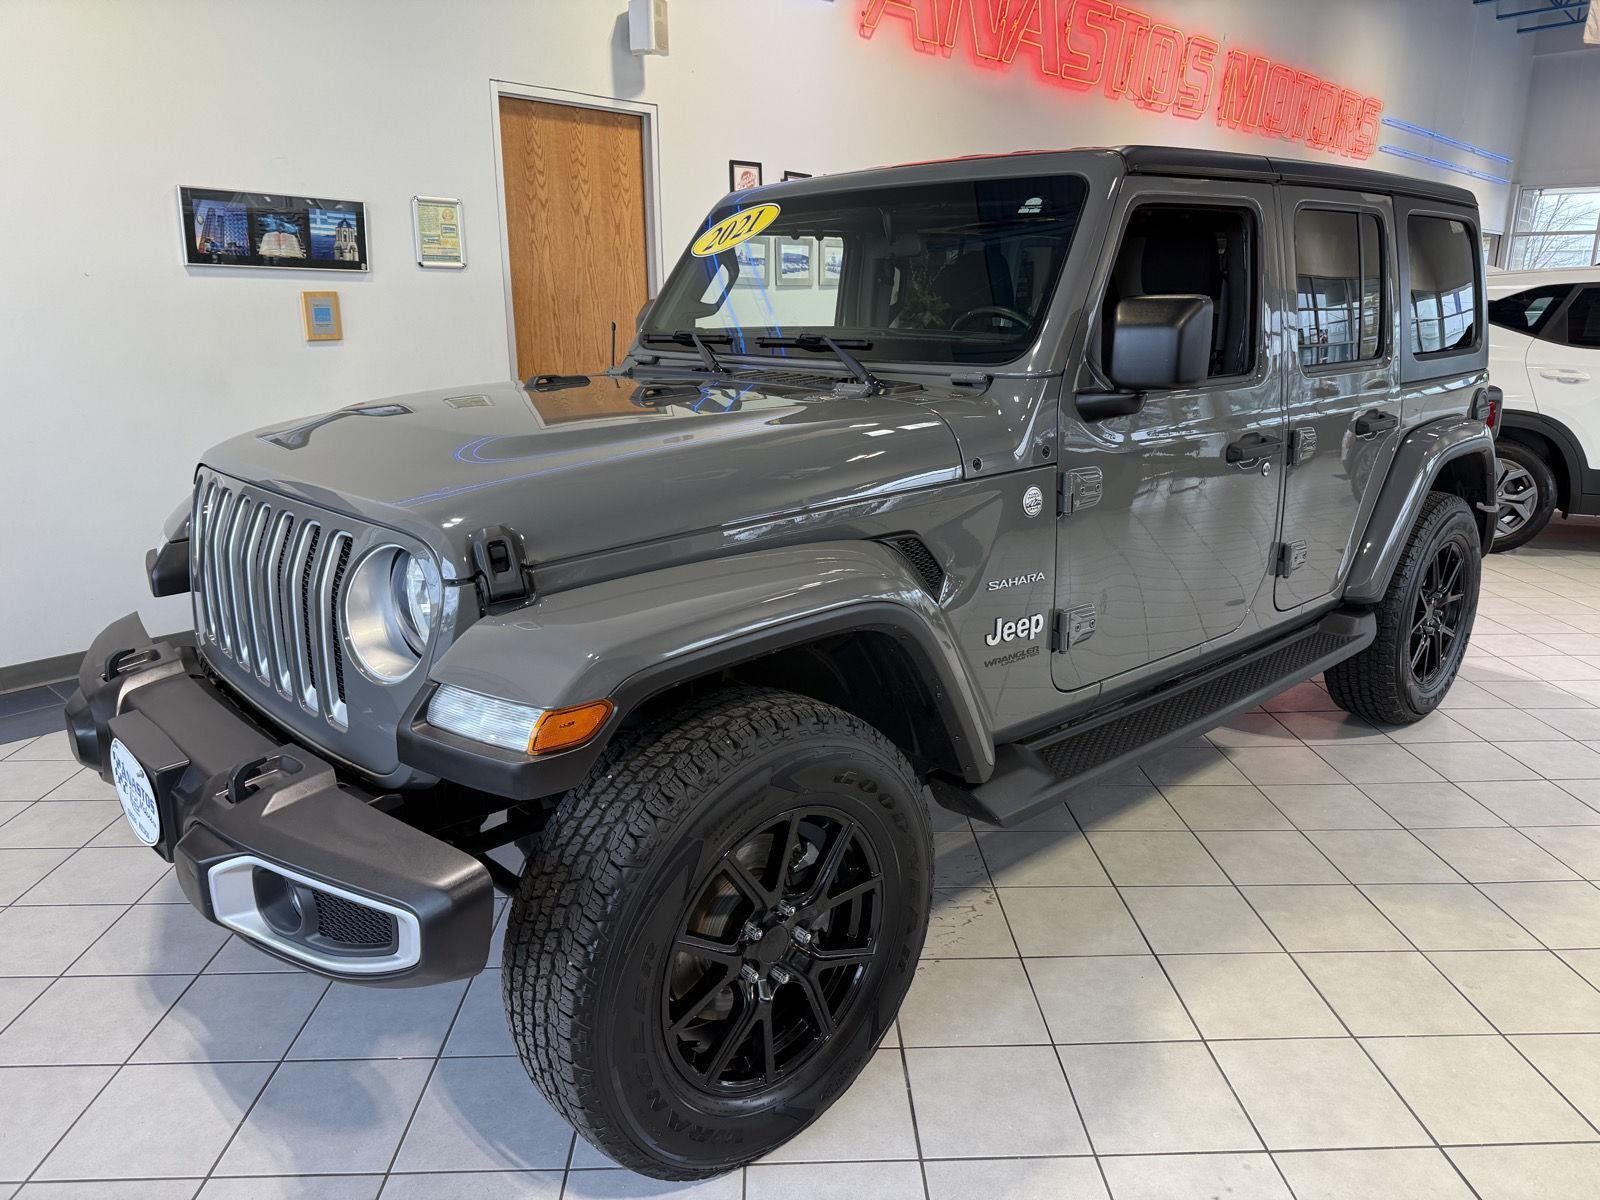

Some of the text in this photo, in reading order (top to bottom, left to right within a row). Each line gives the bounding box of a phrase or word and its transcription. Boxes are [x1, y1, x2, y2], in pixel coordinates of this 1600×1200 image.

[1218, 51, 1383, 158] MOTORS
[702, 208, 766, 252] 2021
[988, 572, 1045, 591] SAHARA
[985, 613, 1044, 646] Jeep
[984, 646, 1040, 668] WRANGLER
